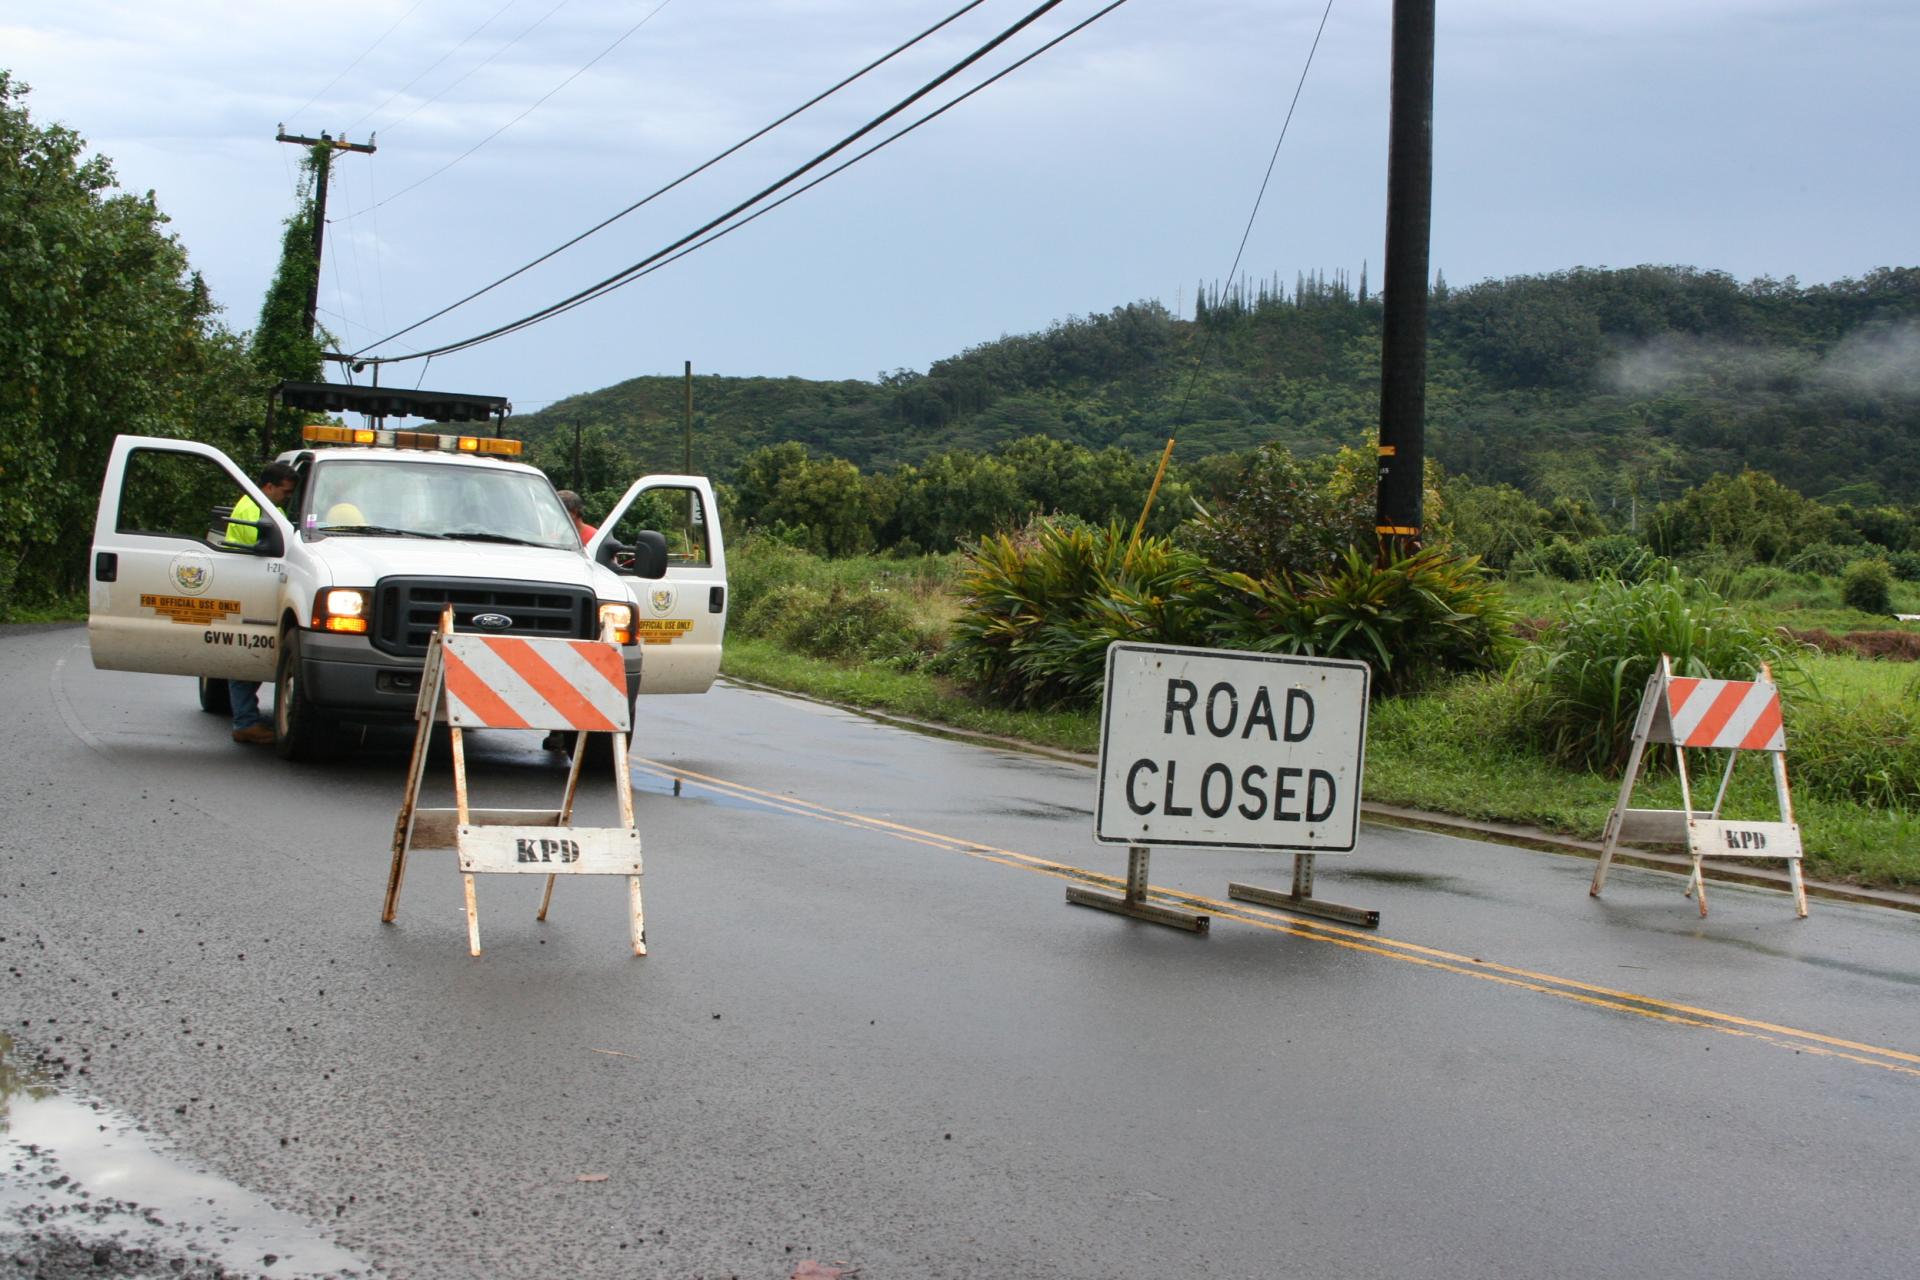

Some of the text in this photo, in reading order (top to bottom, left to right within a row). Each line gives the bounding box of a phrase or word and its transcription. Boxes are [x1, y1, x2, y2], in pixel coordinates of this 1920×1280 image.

[160, 597, 195, 609] OFFICIAL
[199, 599, 215, 610] USE
[219, 601, 240, 612] ONLY
[664, 620, 675, 630] USE
[677, 620, 691, 630] ONLY
[204, 631, 275, 649] GVW 11,200
[1164, 678, 1315, 743] ROAD
[1126, 758, 1337, 823] CLOSED
[1726, 830, 1766, 849] KPD
[516, 838, 580, 863] KPD
